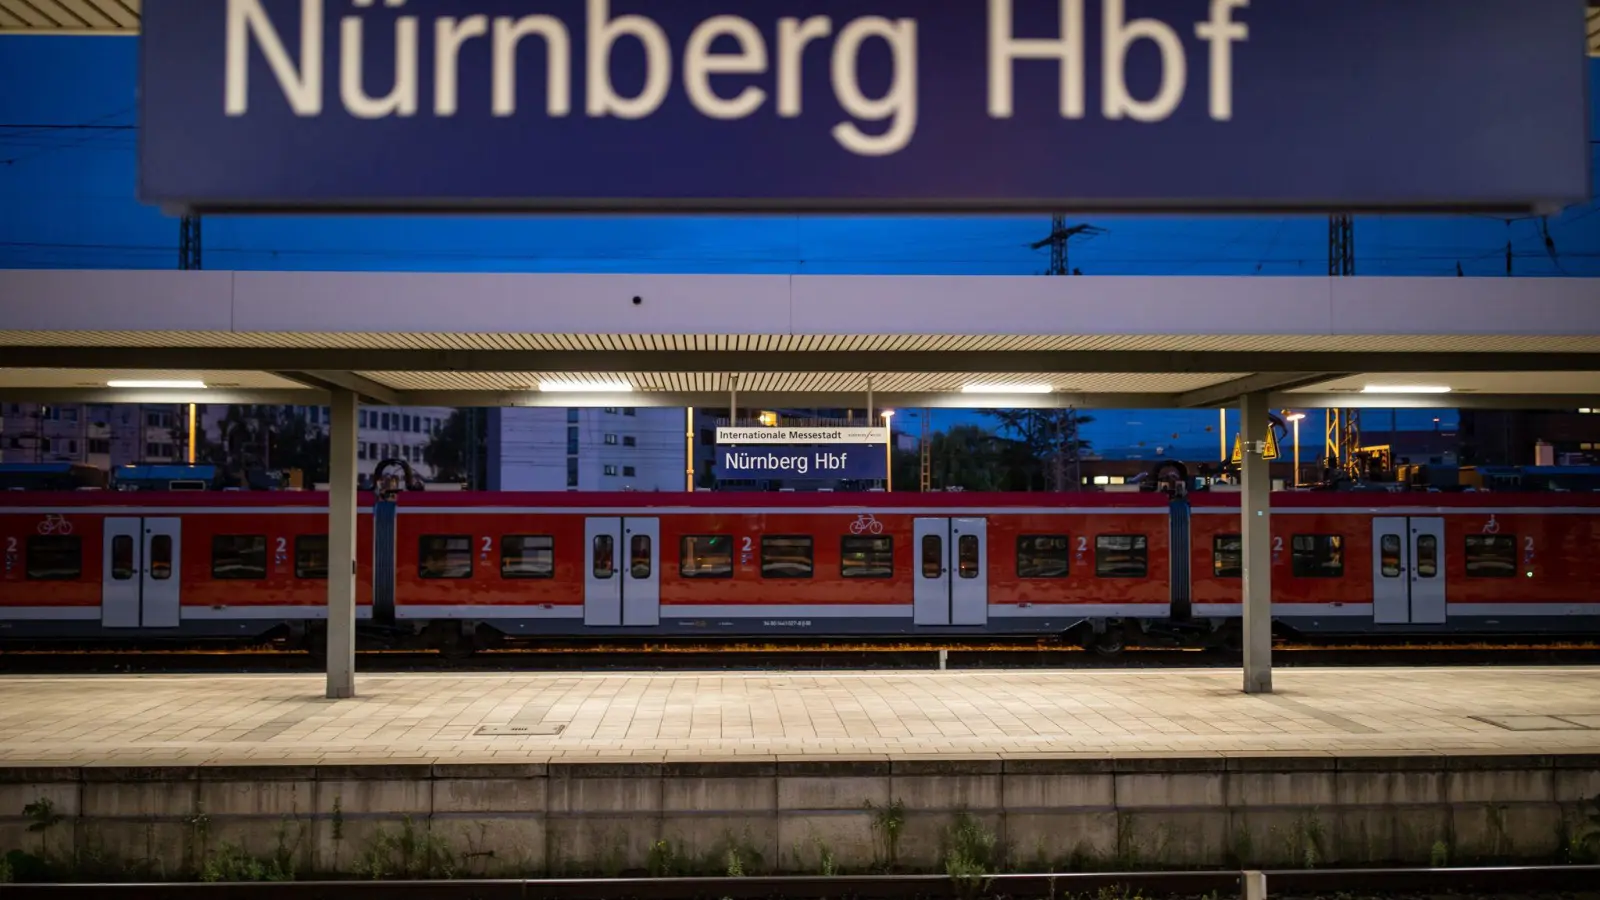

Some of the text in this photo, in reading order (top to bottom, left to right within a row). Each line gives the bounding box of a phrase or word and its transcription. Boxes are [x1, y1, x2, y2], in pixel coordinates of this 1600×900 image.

[225, 0, 1249, 156] Nürnberg Hbf
[720, 431, 786, 439] Internationale
[789, 431, 842, 439] Messestadt
[725, 452, 847, 474] Nürnberg Hbf
[7, 537, 17, 552] 2
[276, 537, 287, 552] 2
[482, 537, 492, 551] 2
[742, 537, 752, 551] 2
[1077, 537, 1087, 551] 2
[1273, 537, 1283, 551] 2
[1524, 537, 1534, 551] 2
